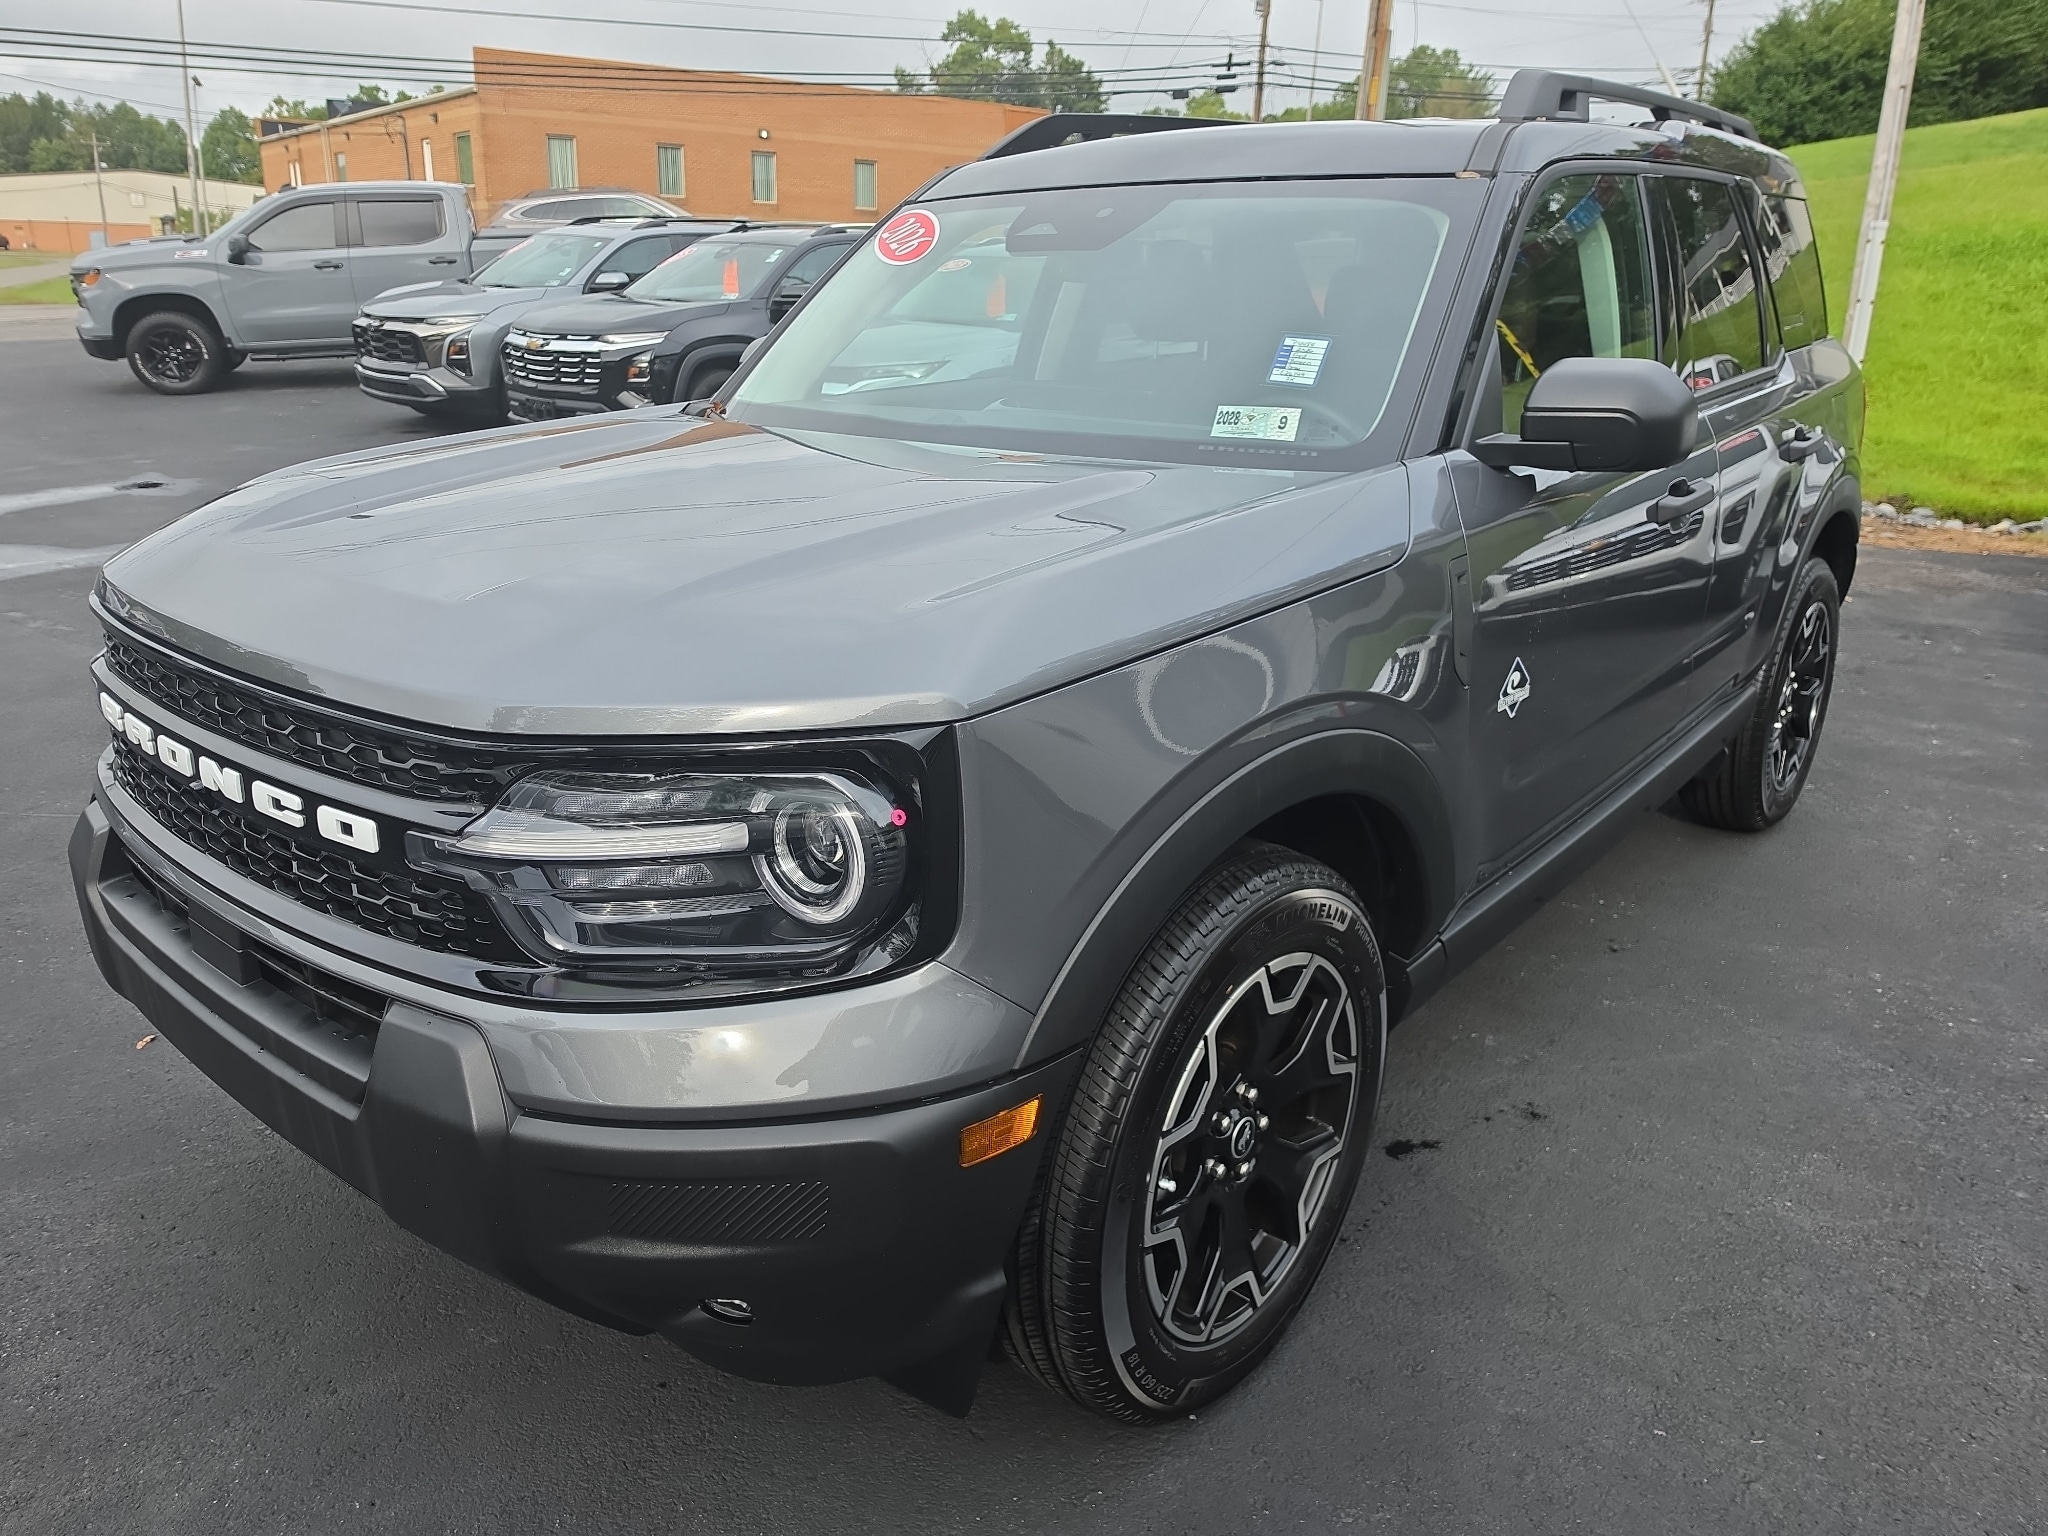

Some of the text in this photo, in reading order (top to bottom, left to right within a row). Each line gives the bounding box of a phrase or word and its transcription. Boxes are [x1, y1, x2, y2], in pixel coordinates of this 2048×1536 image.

[881, 217, 933, 256] 2026
[1216, 411, 1289, 430] 2028 9
[100, 692, 381, 854] BRONCO
[1276, 902, 1350, 928] MICHELIN
[1354, 922, 1378, 964] PRIMACY
[1127, 1352, 1141, 1368] 18
[1134, 1365, 1148, 1378] R
[1140, 1374, 1175, 1400] 225/60
